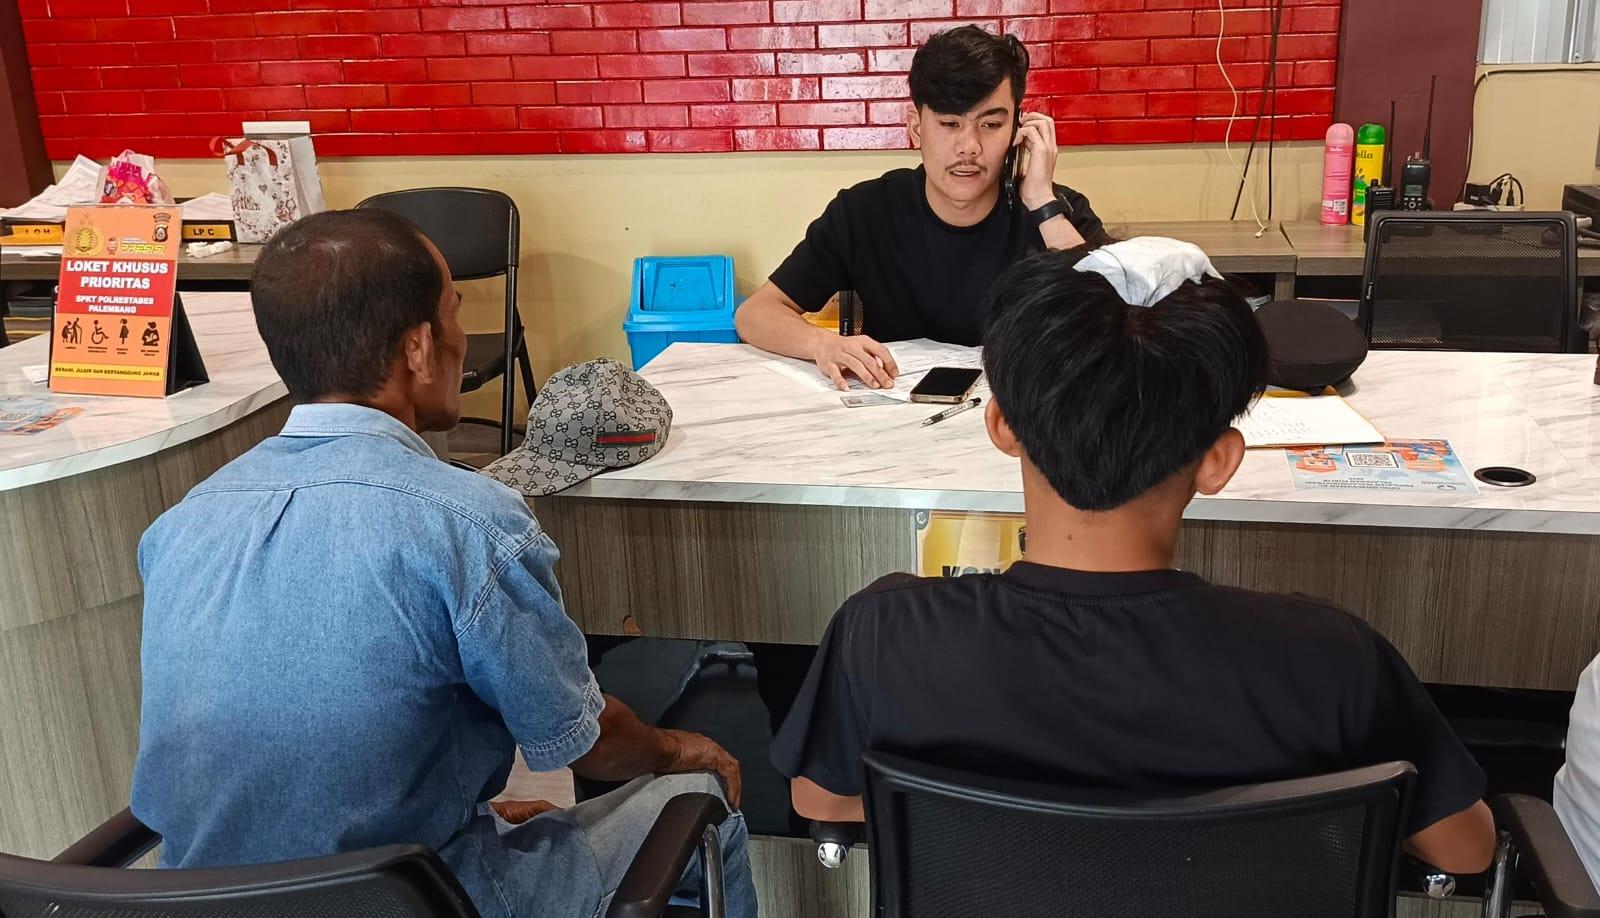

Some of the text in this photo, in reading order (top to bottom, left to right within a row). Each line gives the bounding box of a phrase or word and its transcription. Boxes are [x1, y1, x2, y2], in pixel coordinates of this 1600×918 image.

[192, 228, 204, 236] LP
[66, 260, 168, 274] LOKET KHUSUS
[80, 276, 151, 289] PRIORITAS
[76, 295, 154, 305] SPKT POLRESTABES
[88, 305, 137, 313] PALEMBANG
